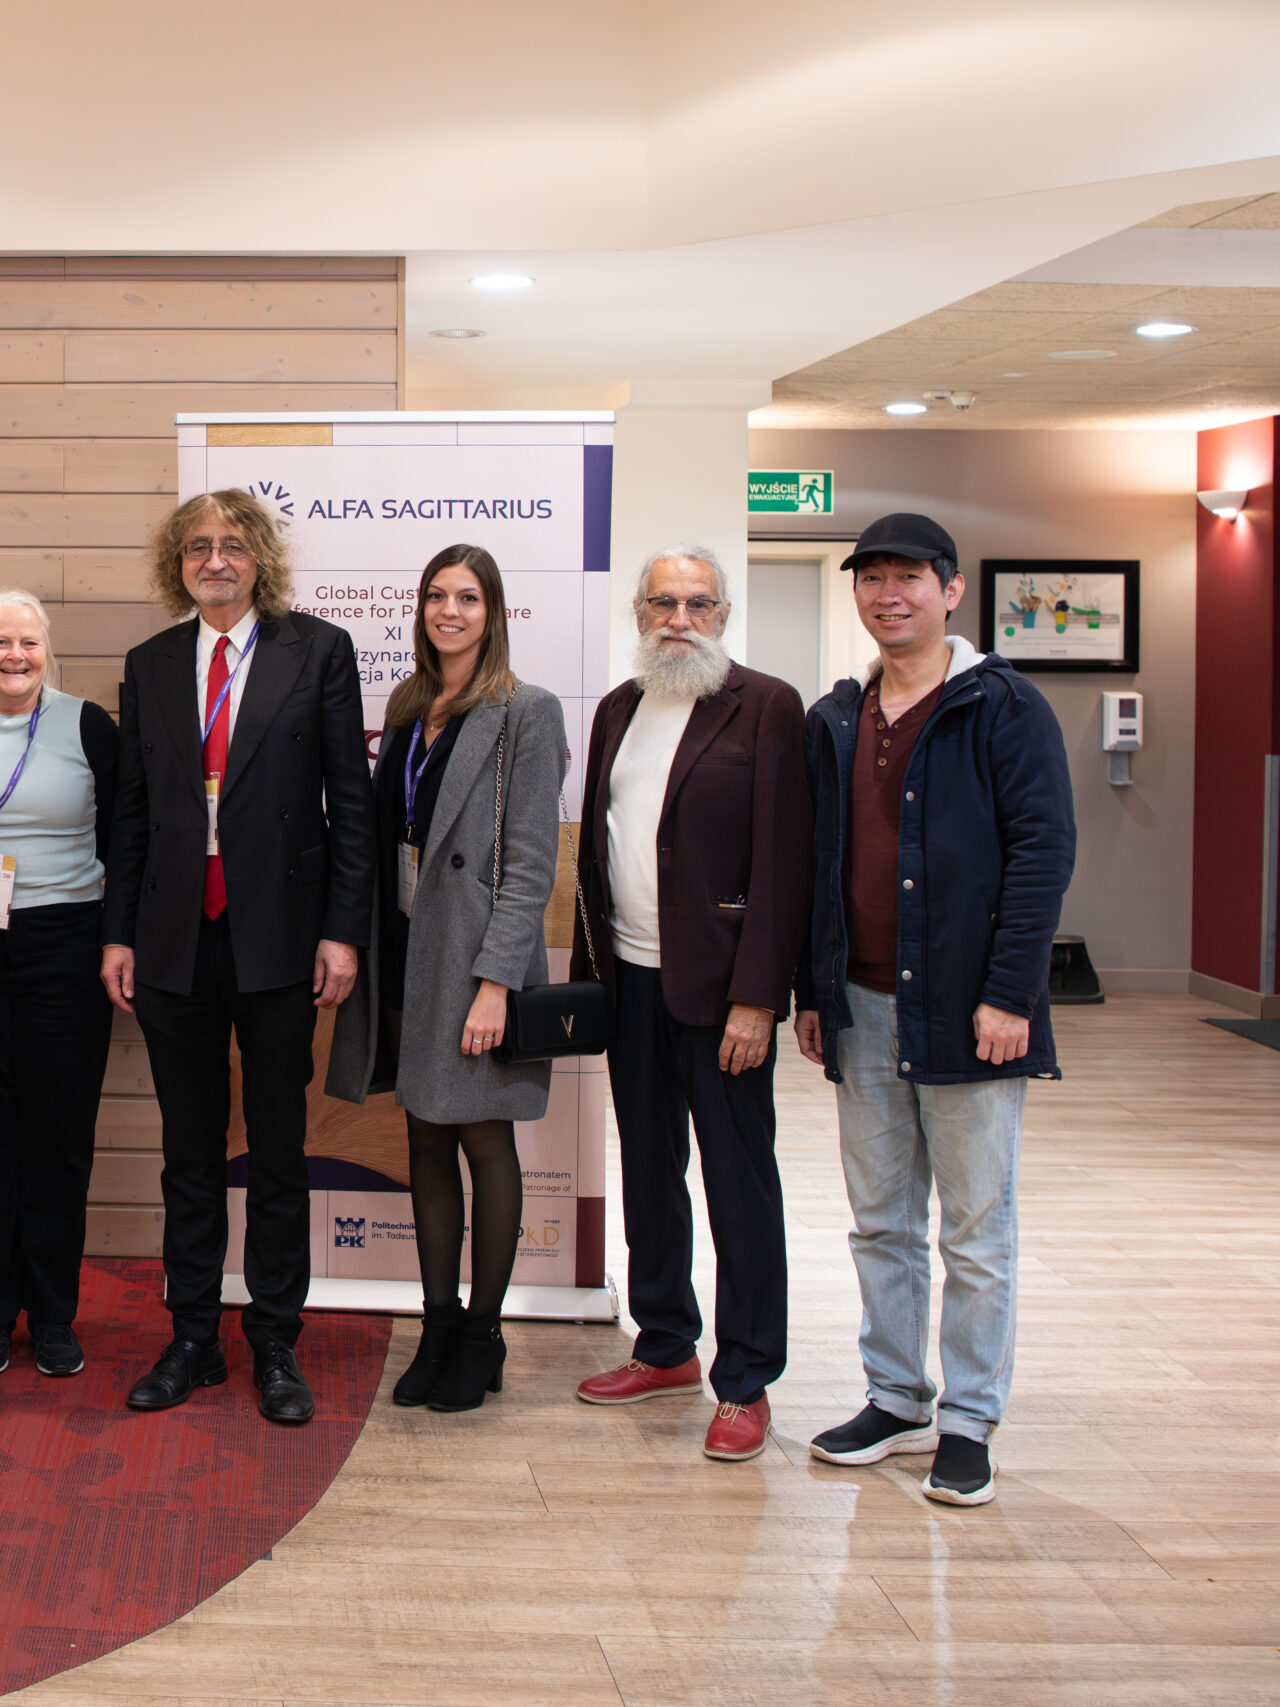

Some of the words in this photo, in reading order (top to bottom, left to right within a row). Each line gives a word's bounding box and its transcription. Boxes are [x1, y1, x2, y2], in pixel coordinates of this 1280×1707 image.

[749, 482, 798, 493] WYJŚCIE
[307, 499, 374, 519] ALFA
[382, 499, 553, 519] SAGITTARIUS
[315, 586, 374, 600] Global
[380, 586, 421, 600] Cust
[293, 604, 364, 619] ference
[370, 604, 394, 619] for
[505, 608, 532, 619] are
[384, 626, 402, 641] XI
[521, 1171, 571, 1179] atronatem
[372, 1222, 416, 1230] Politechnik
[336, 1236, 365, 1247] PK
[372, 1232, 383, 1240] im.
[386, 1232, 416, 1240] Tadeus
